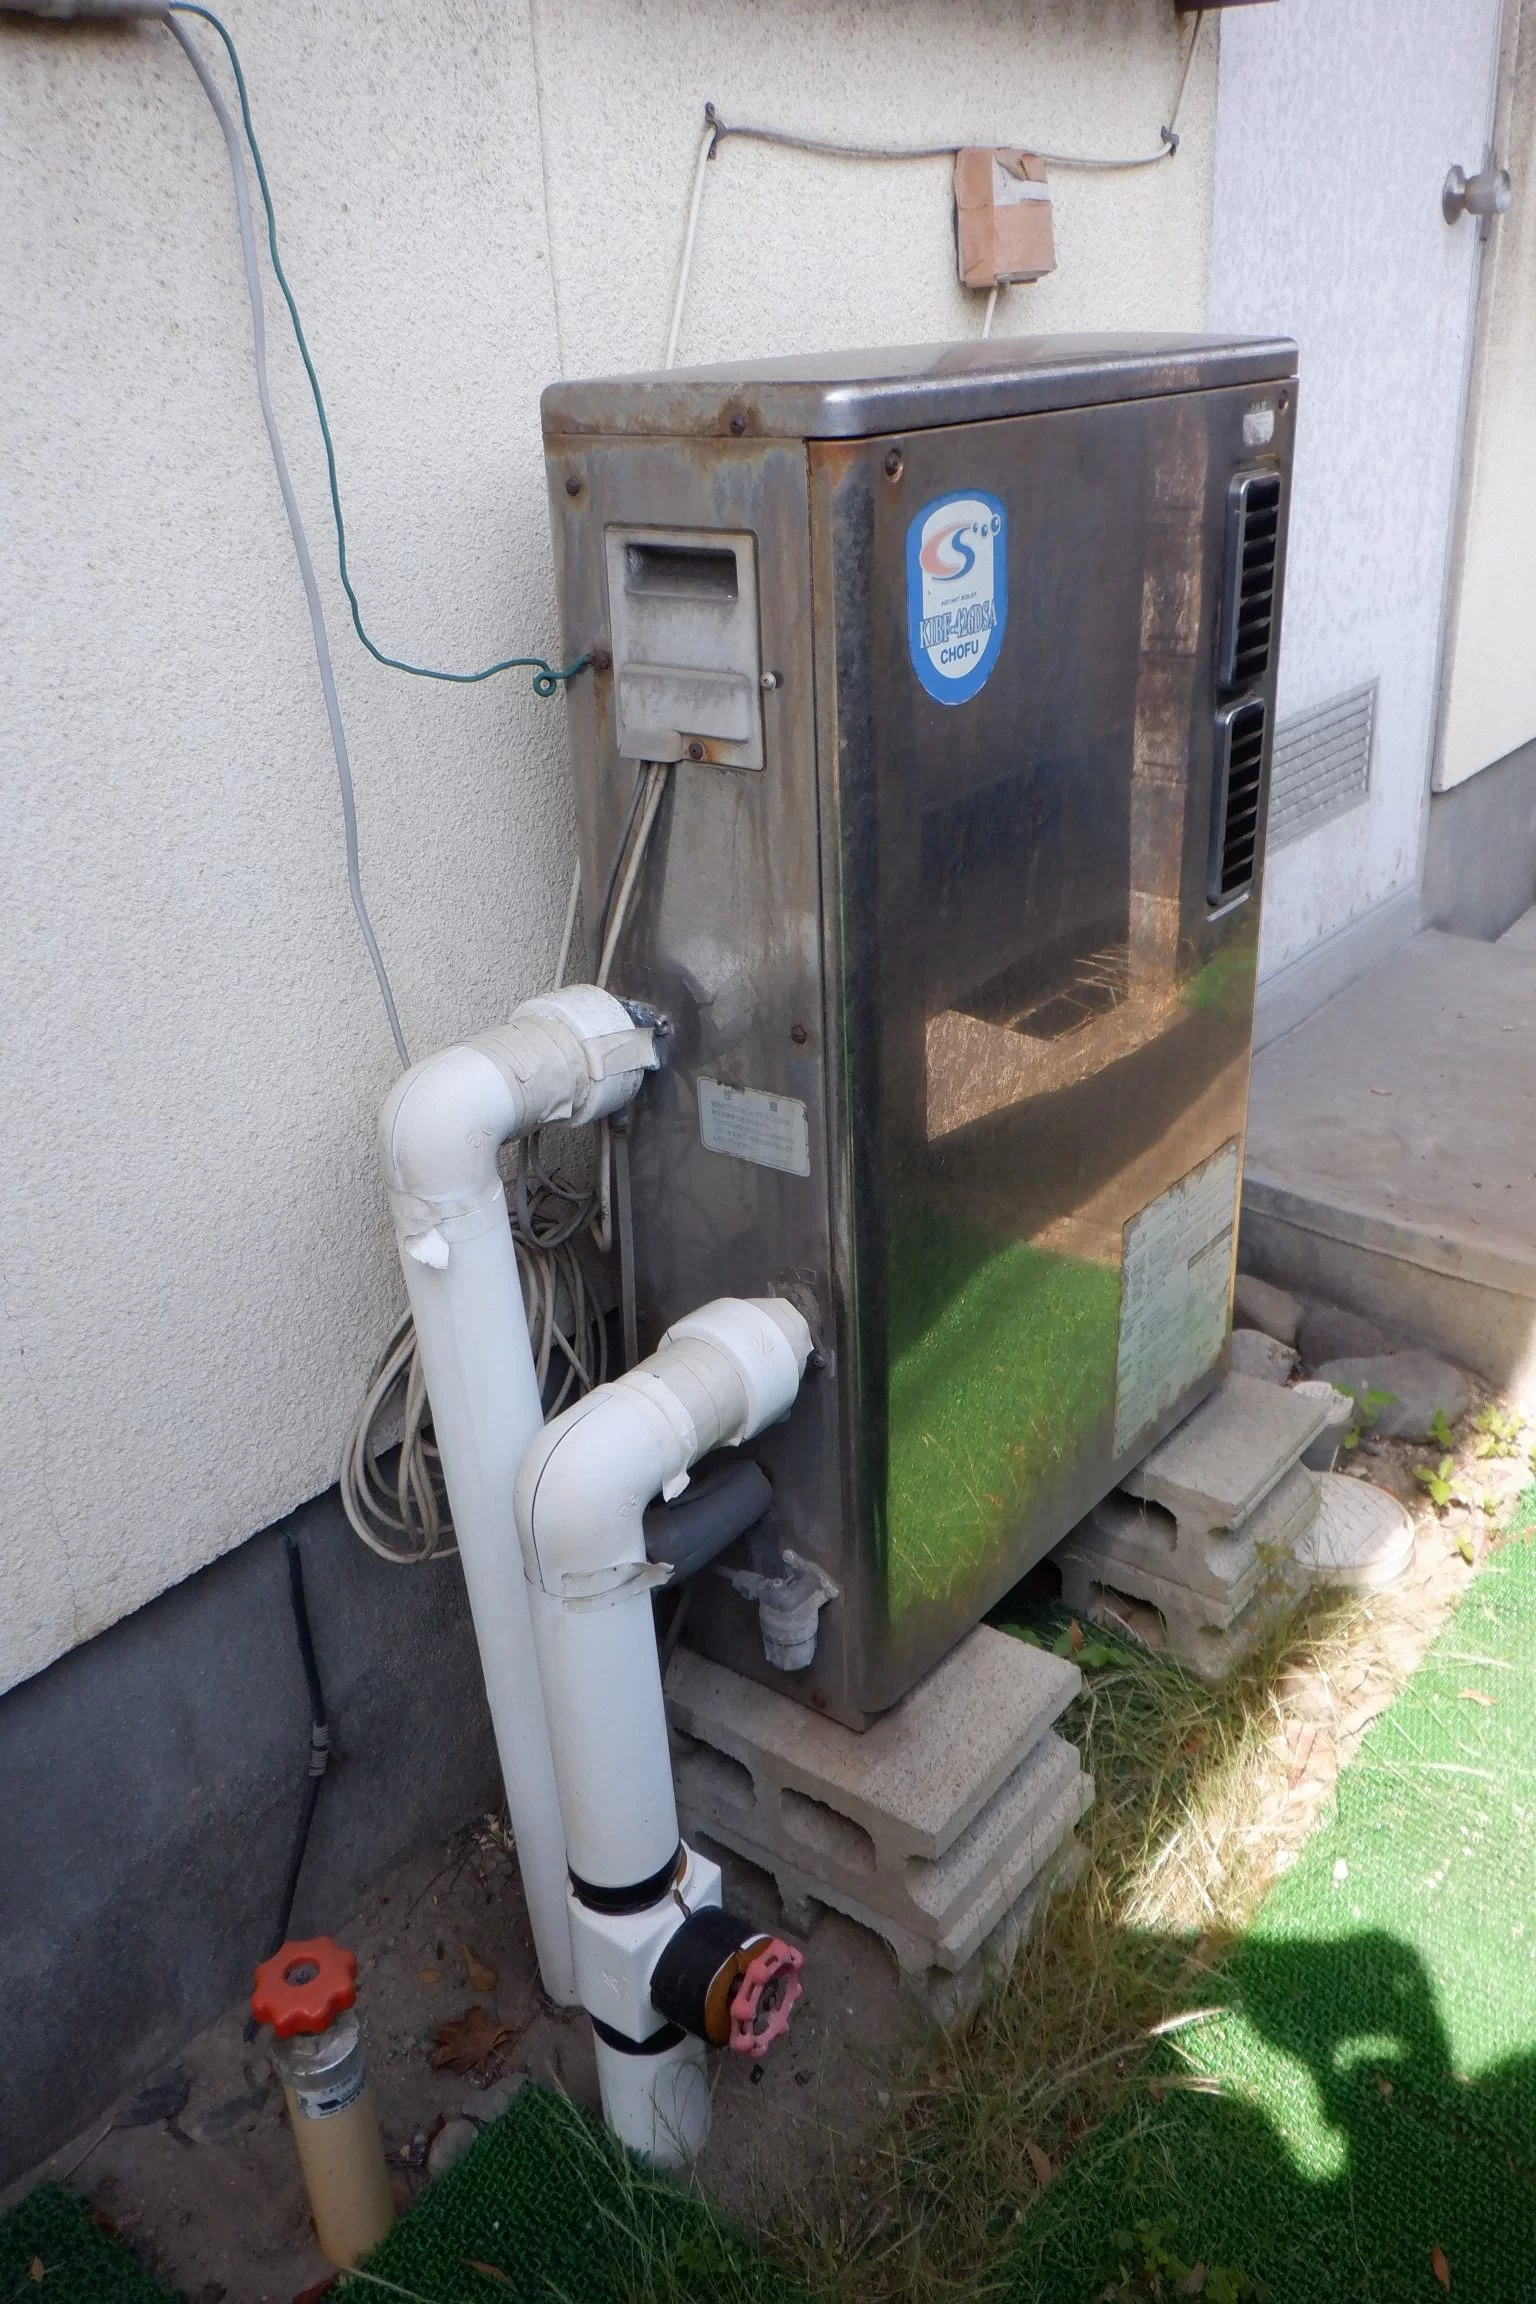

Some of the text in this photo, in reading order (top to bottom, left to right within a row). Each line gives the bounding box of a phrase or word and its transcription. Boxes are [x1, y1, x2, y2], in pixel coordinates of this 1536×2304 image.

[941, 592, 977, 607] INSTANT BOILER
[940, 640, 979, 665] CHOFU
